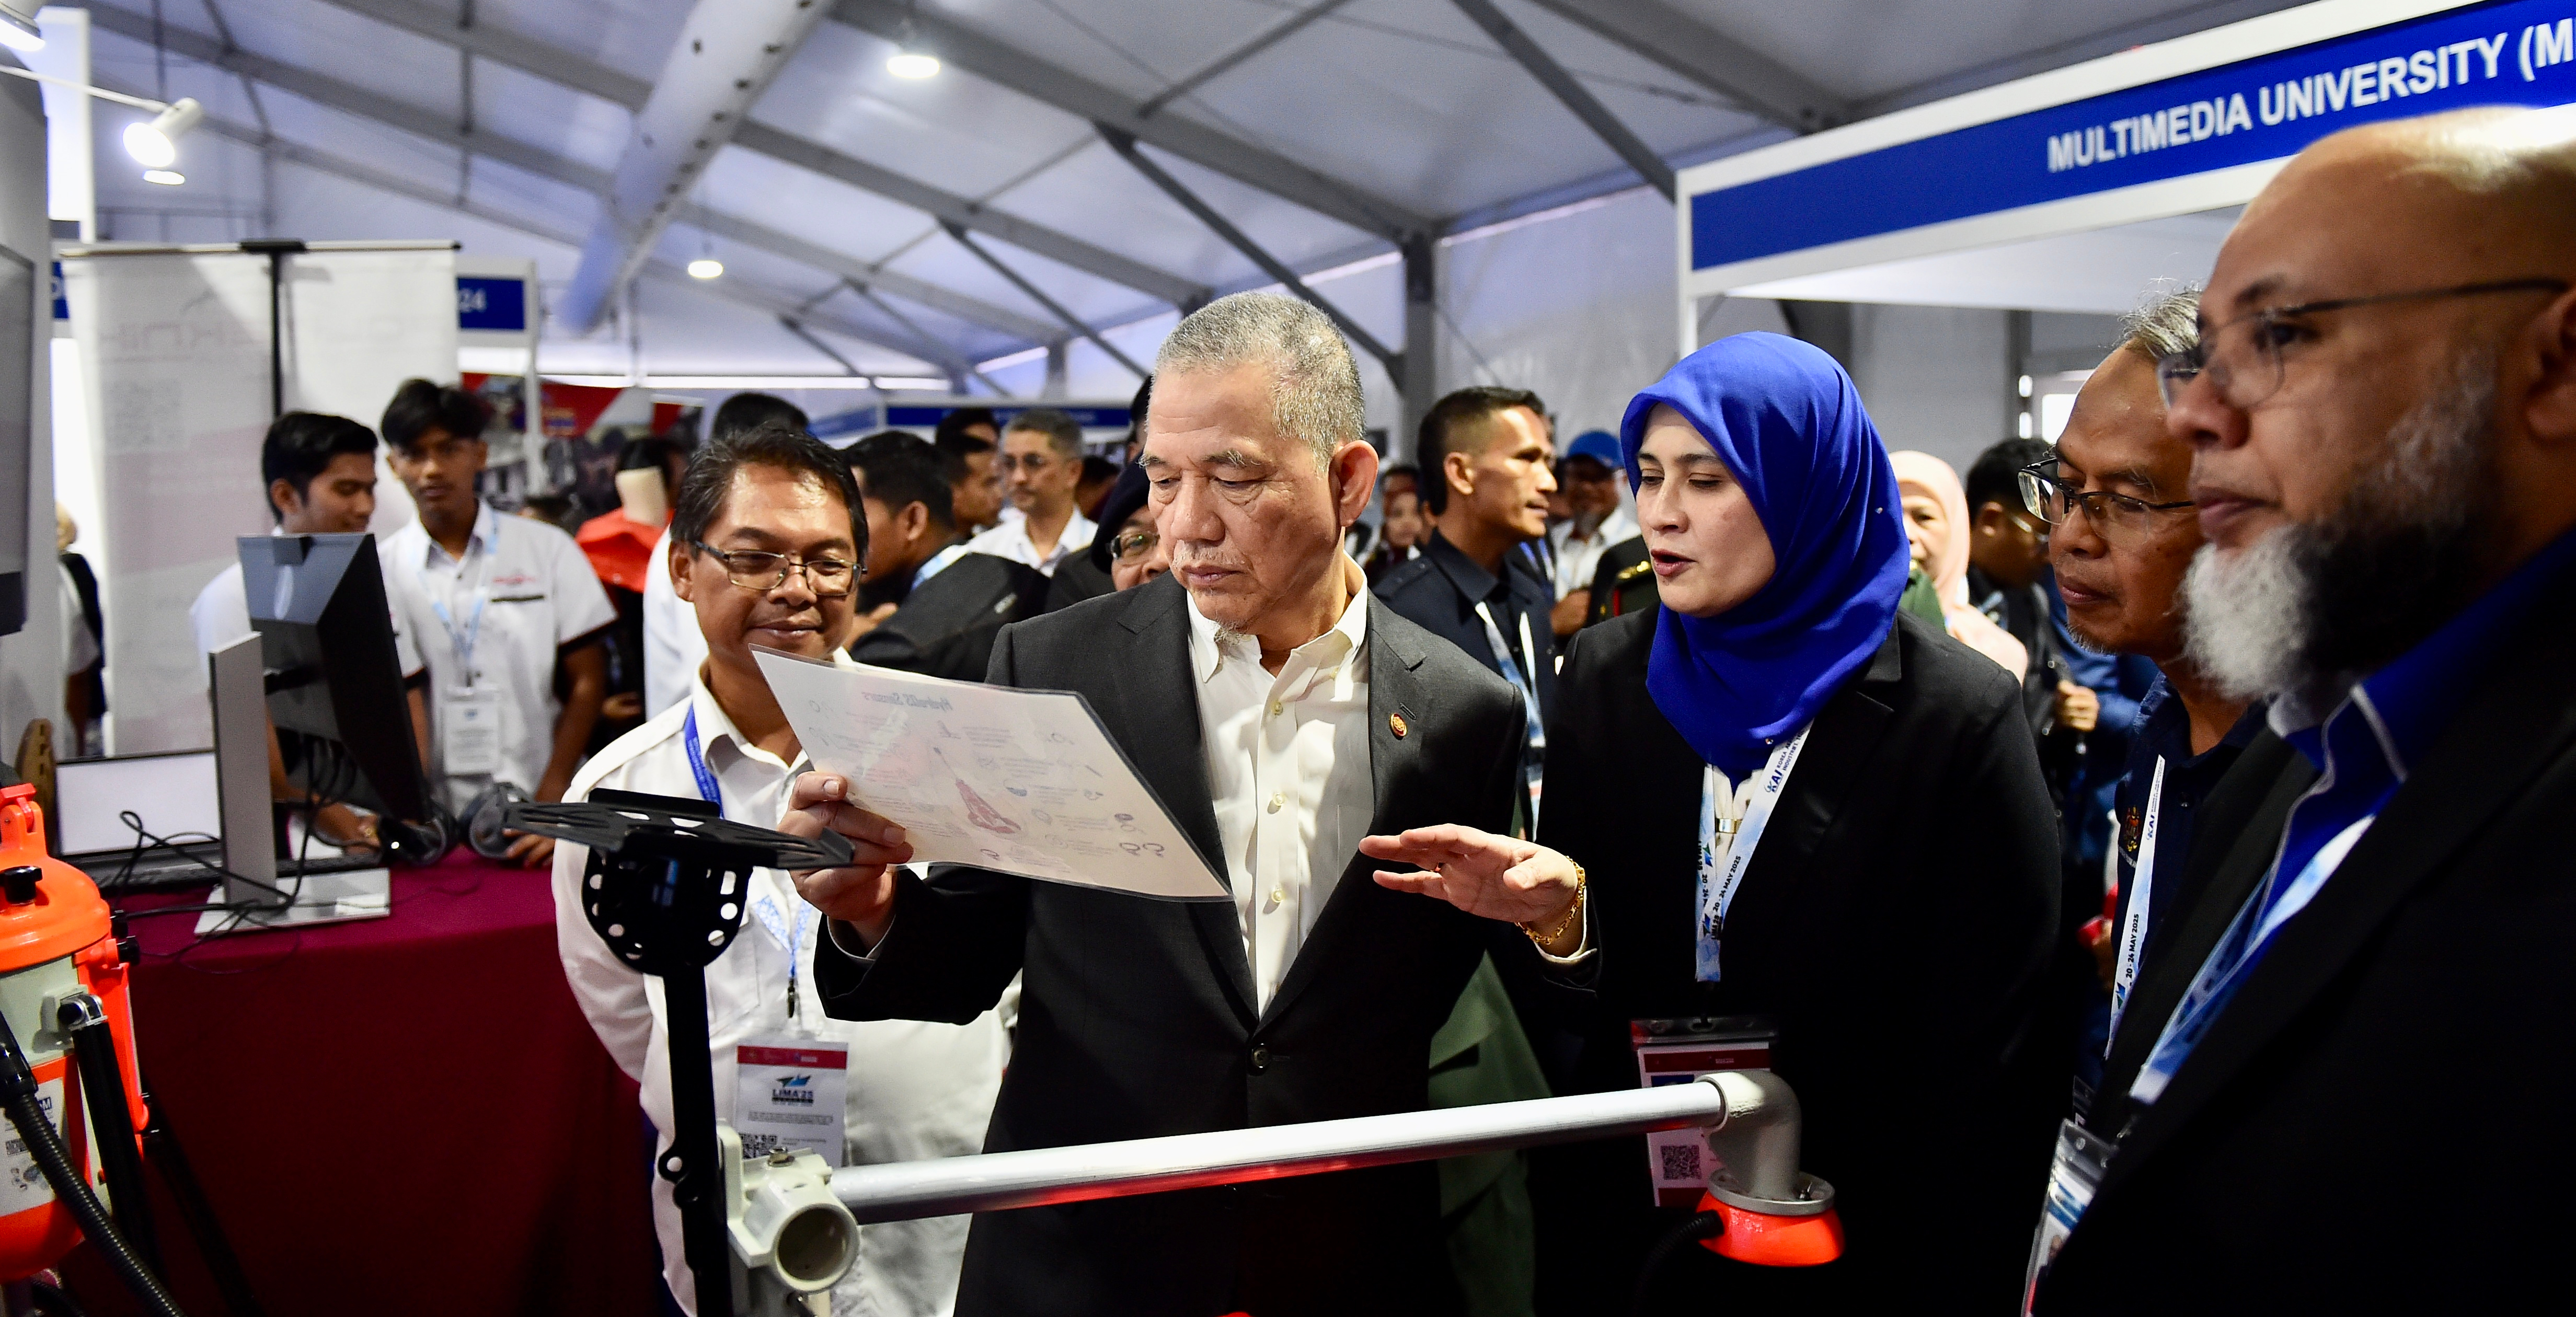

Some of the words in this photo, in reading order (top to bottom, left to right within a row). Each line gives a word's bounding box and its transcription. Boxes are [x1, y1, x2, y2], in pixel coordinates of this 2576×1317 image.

[2047, 91, 2253, 173] MULTIMEDIA
[2258, 32, 2508, 126] UNIVERSITY
[2518, 17, 2576, 83] (M
[1777, 752, 1787, 768] KOREA
[1764, 769, 1782, 793] KAI
[1702, 874, 1708, 884] 20
[1713, 902, 1720, 912] 20
[1719, 889, 1726, 898] 24
[1723, 872, 1733, 889] MAY
[1730, 855, 1741, 873] 2025
[2128, 953, 2134, 963] 24
[2126, 969, 2133, 978] 20
